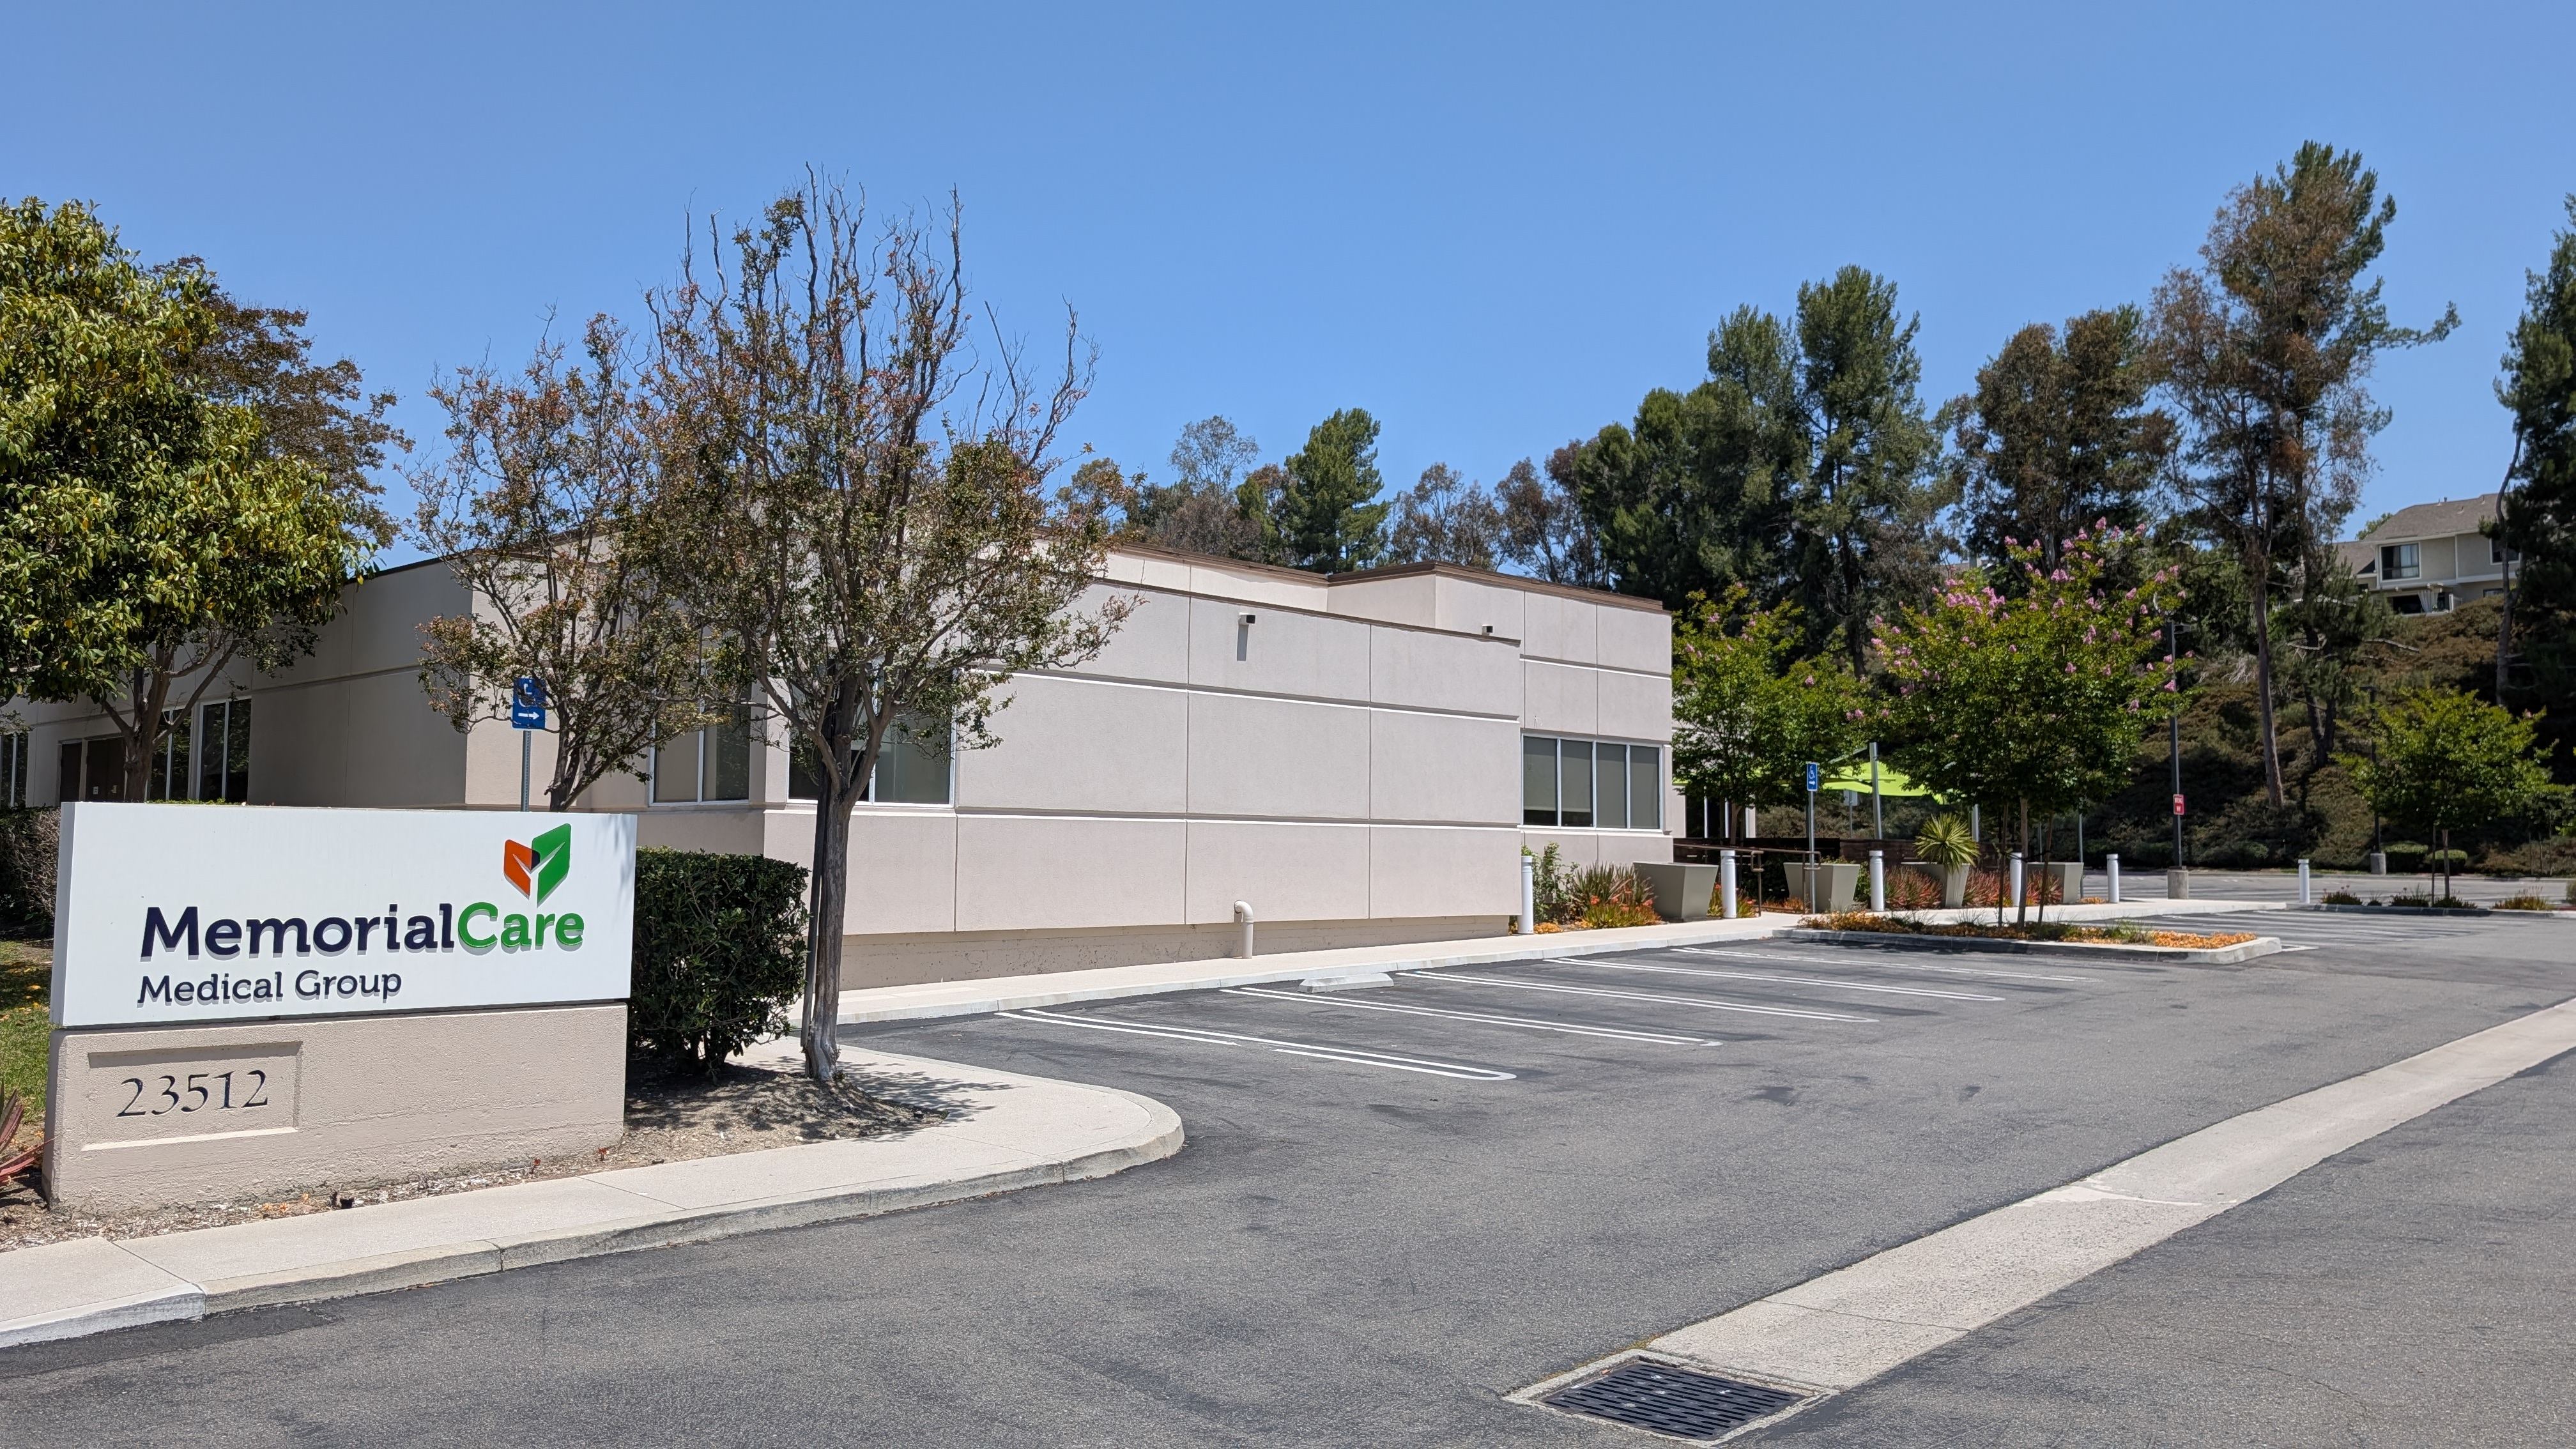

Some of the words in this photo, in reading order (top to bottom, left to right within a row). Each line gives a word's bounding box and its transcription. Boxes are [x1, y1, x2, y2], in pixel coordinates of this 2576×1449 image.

[141, 902, 584, 958] MemorialCare
[137, 971, 284, 1004] Medical
[295, 969, 402, 1000] Group
[116, 1070, 268, 1117] 23512
